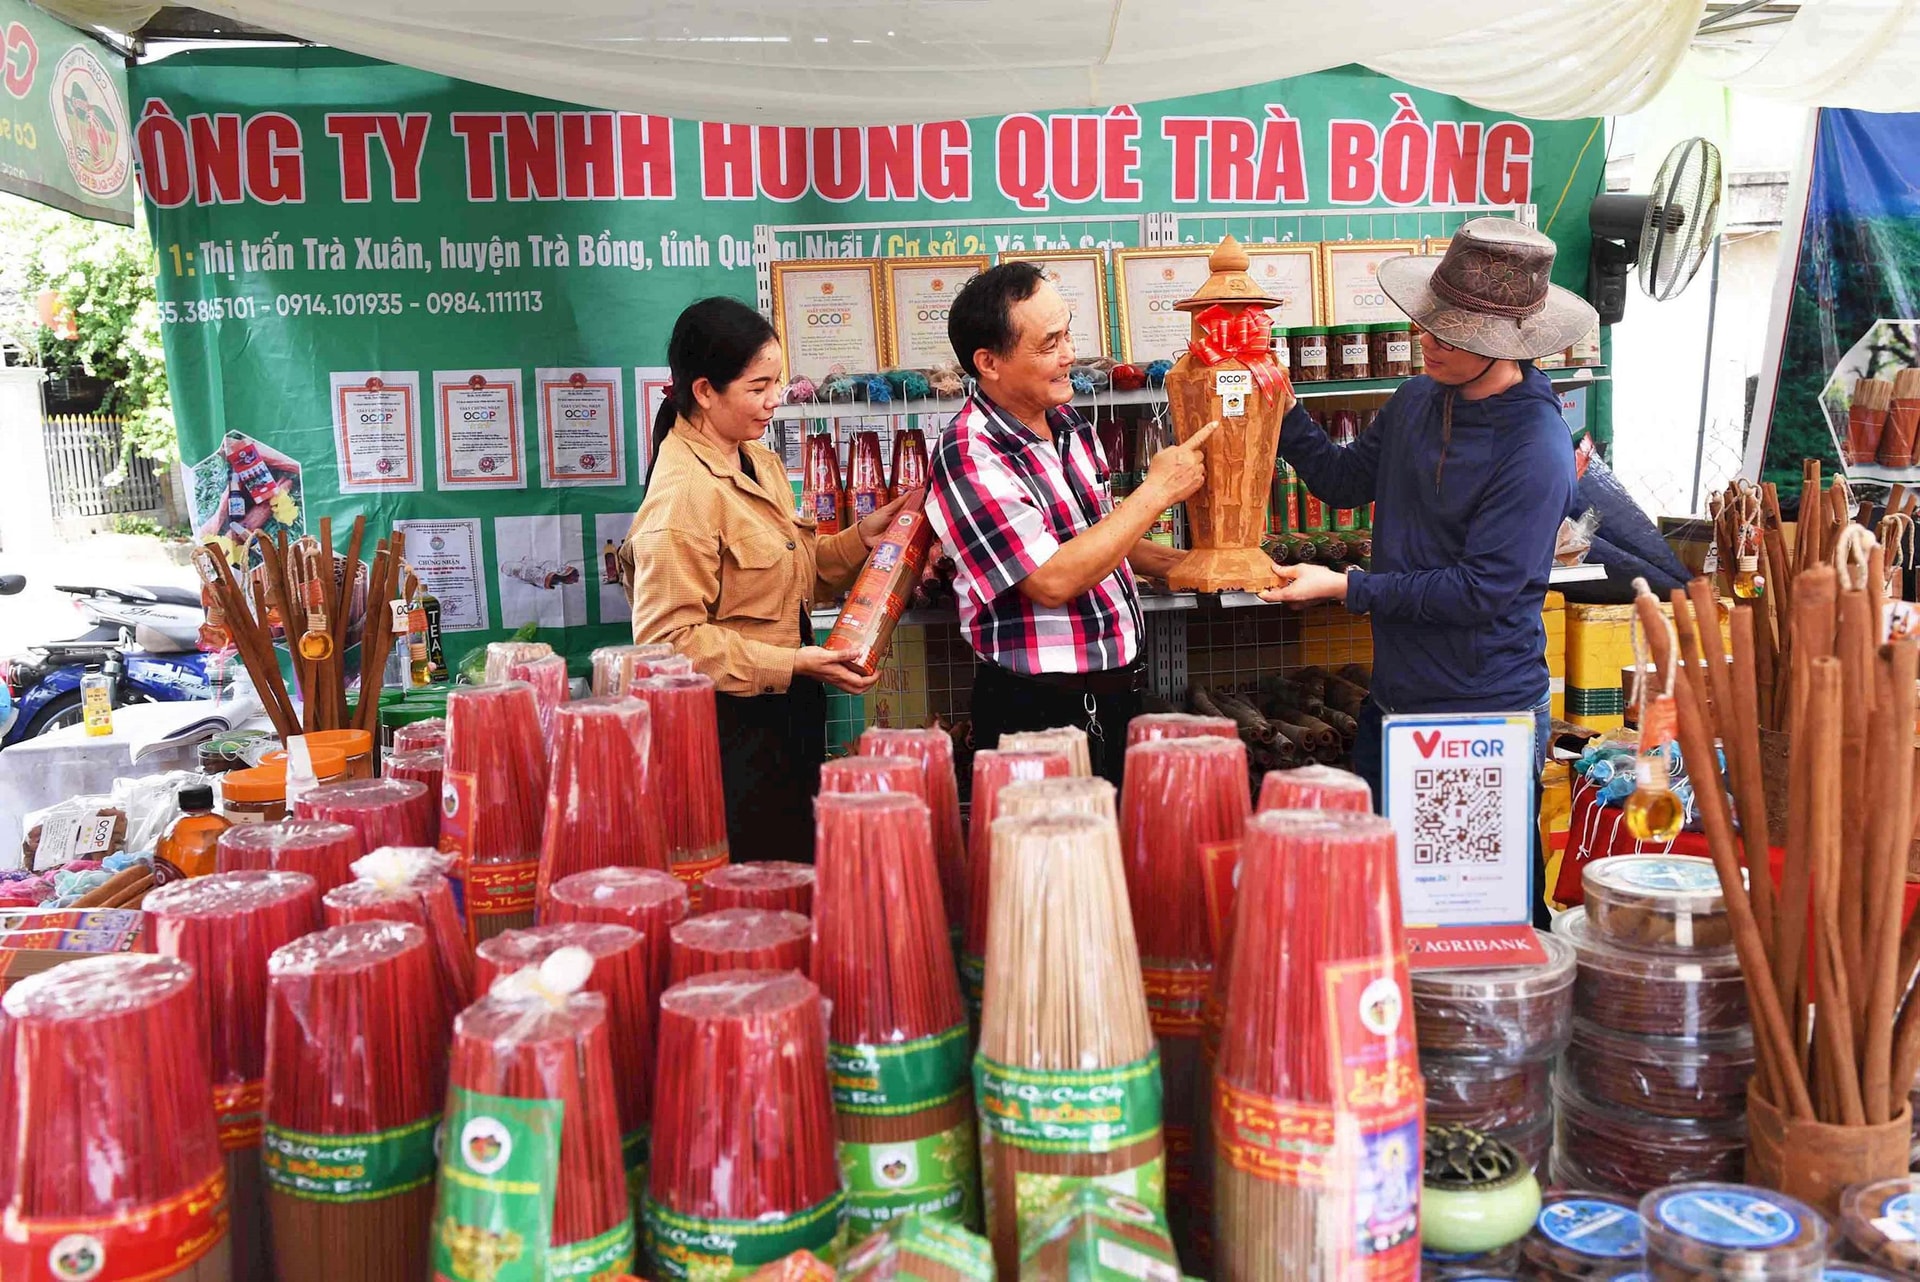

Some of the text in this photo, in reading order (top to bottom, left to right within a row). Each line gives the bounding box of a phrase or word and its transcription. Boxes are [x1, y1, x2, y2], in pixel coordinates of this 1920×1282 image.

[133, 98, 304, 208] ÔNG
[325, 113, 431, 202] TY
[451, 111, 676, 202] TNHH
[1161, 104, 1308, 204] TRÀ
[1329, 92, 1534, 206] BỒNG
[169, 244, 196, 277] 1:
[200, 240, 236, 281] Thị
[242, 231, 294, 272] trấn
[303, 237, 346, 271] Trà
[355, 236, 431, 274] Xuân,
[440, 234, 520, 275] huyện
[528, 233, 569, 268] Trà
[578, 230, 653, 270] Bồng,
[660, 230, 710, 267] tỉnh
[276, 294, 403, 316] 0914.101935
[426, 290, 544, 315] 0984.111113
[807, 313, 852, 325] OCOP
[1219, 375, 1247, 383] OCOP
[360, 414, 392, 422] OCOP
[464, 411, 496, 420] OCOP
[565, 409, 596, 418] OCOP
[428, 610, 441, 652] TEA
[1412, 730, 1504, 759] VIETQR
[95, 820, 109, 847] OCOP
[1425, 937, 1531, 953] AGRIBANK
